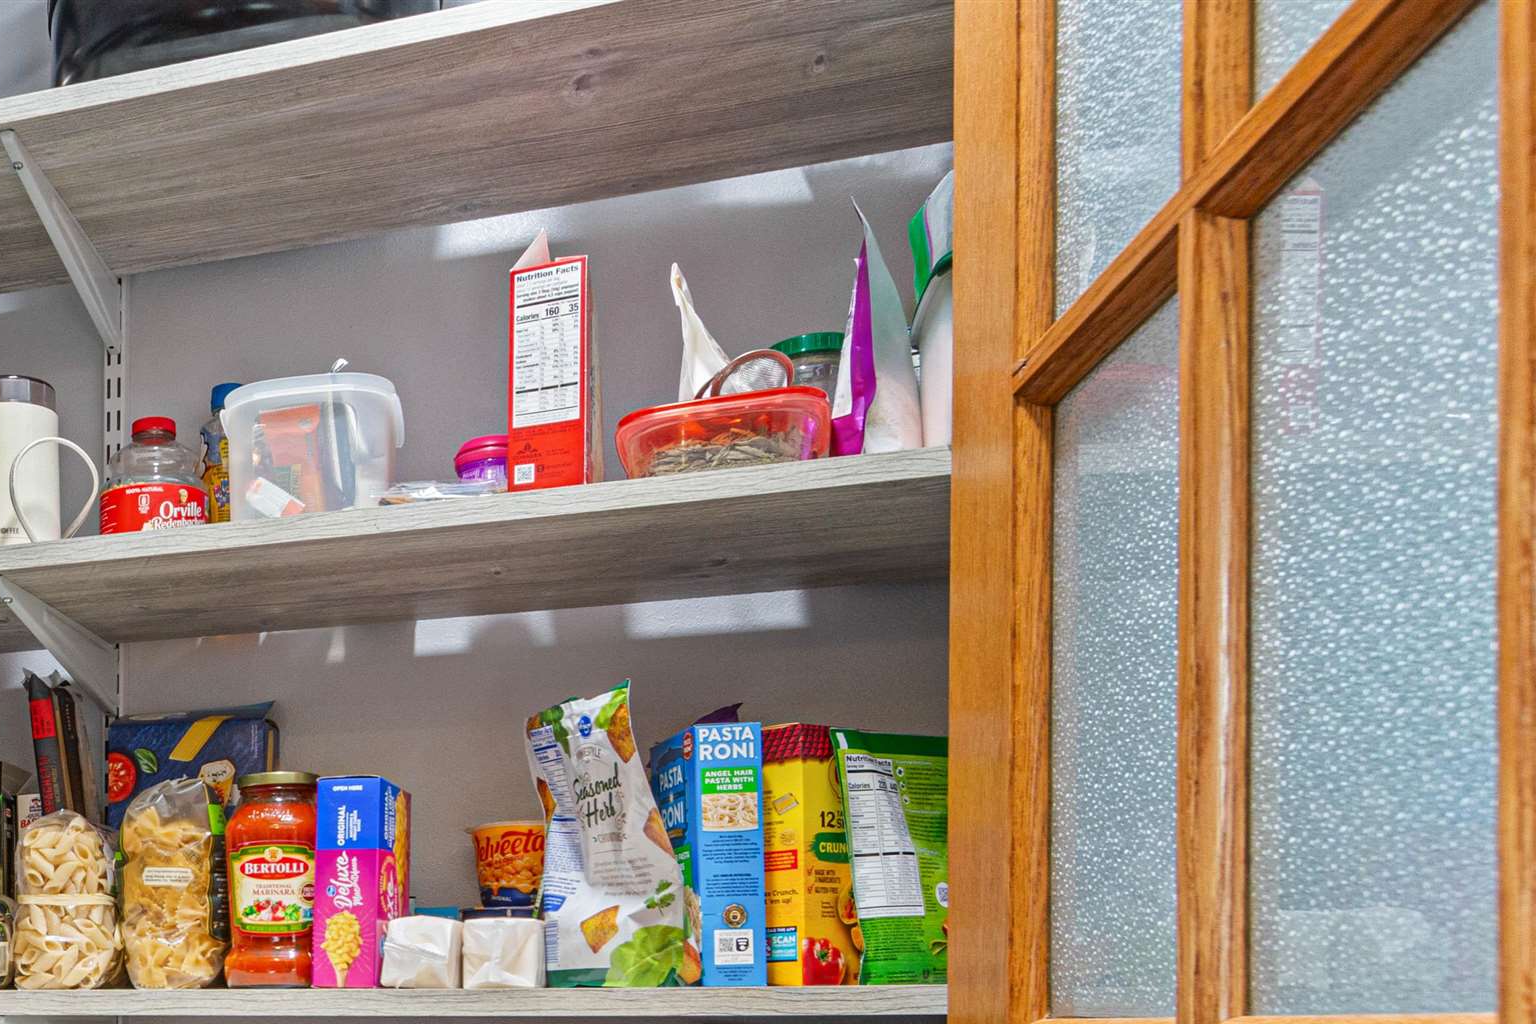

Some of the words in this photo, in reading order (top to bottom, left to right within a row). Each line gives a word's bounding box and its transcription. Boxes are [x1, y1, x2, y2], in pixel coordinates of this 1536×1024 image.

[516, 270, 554, 282] Nutrition
[556, 265, 579, 275] Facts
[545, 306, 560, 317] 160
[568, 303, 579, 313] 35
[160, 501, 202, 519] Orville
[699, 726, 755, 742] PASTA
[699, 742, 755, 761] RONI
[659, 764, 684, 792] PASTA
[705, 769, 731, 777] ANGEL
[734, 769, 753, 777] HAIR
[705, 777, 731, 785] PASTA
[733, 776, 754, 784] WITH
[572, 762, 622, 805] Seasoned
[716, 783, 744, 791] HERBS
[585, 793, 617, 828] Herb
[820, 810, 836, 828] 12
[337, 805, 346, 847] ORIGINAL
[244, 863, 305, 875] BERTOLLI
[332, 850, 350, 910] Deluxe
[252, 888, 295, 897] MARINARA
[772, 935, 796, 944] SCAN
